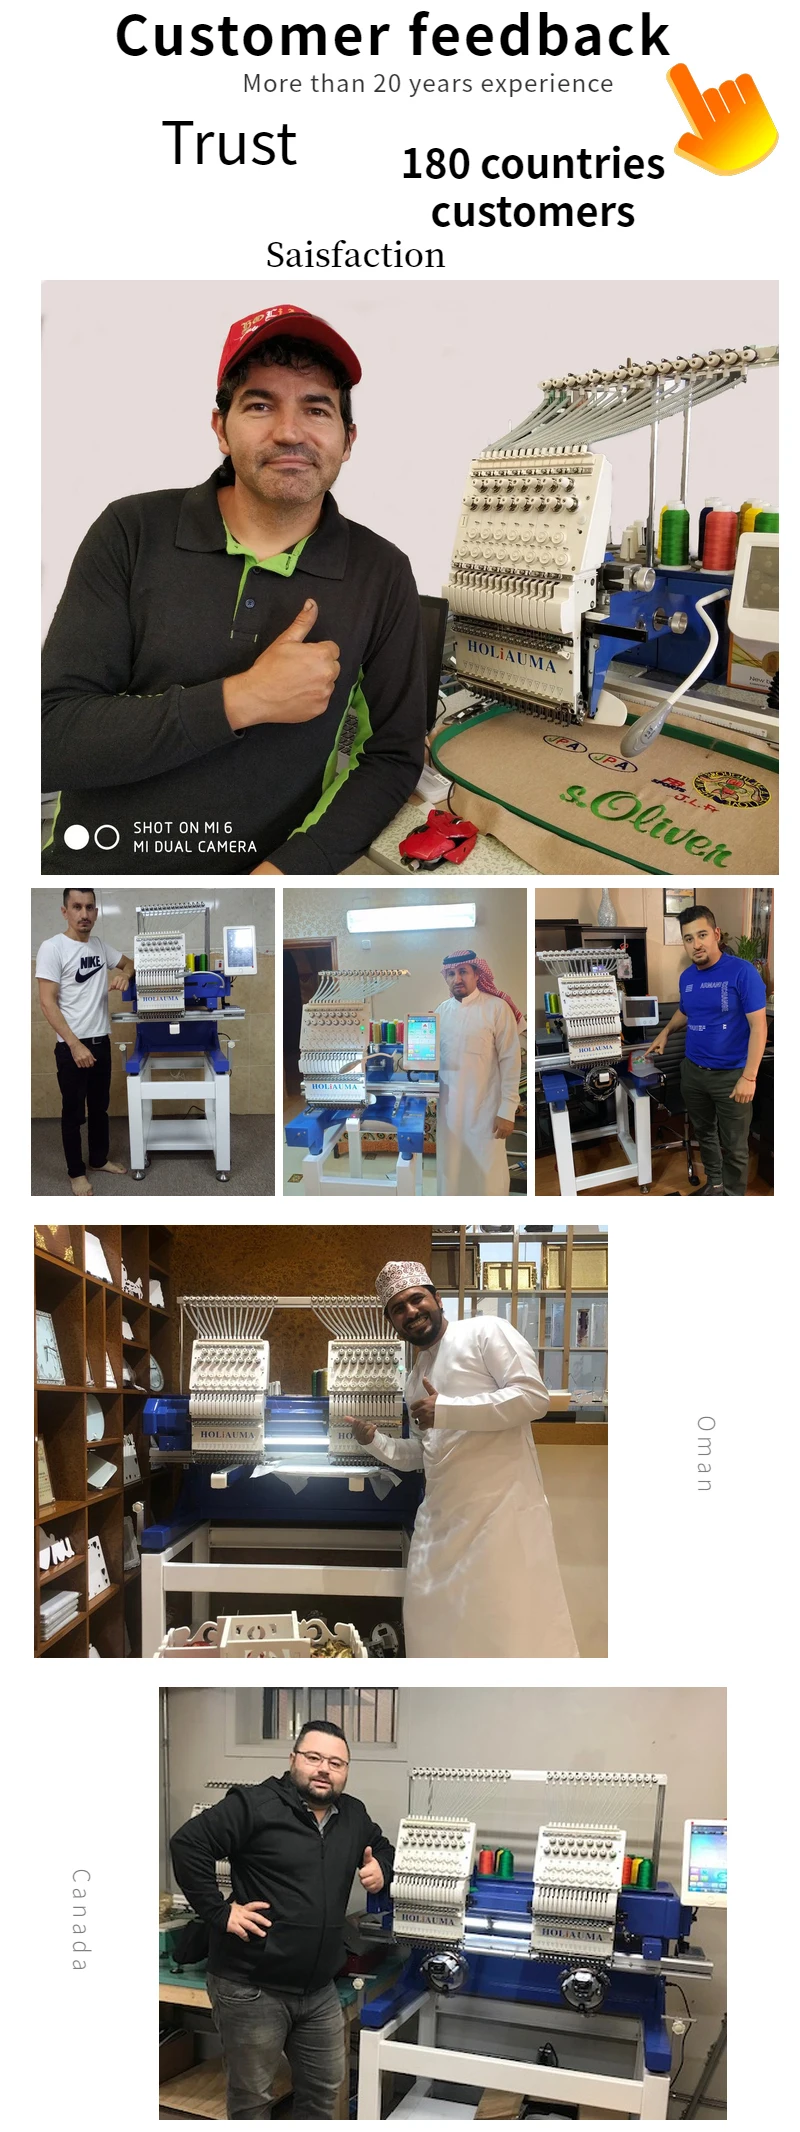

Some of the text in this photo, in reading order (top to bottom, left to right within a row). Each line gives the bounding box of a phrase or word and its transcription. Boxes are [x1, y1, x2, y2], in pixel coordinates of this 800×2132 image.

[468, 640, 556, 673] HOLiAUMA
[547, 737, 580, 751] JPA
[593, 754, 628, 771] JPA
[80, 955, 101, 970] NIKE
